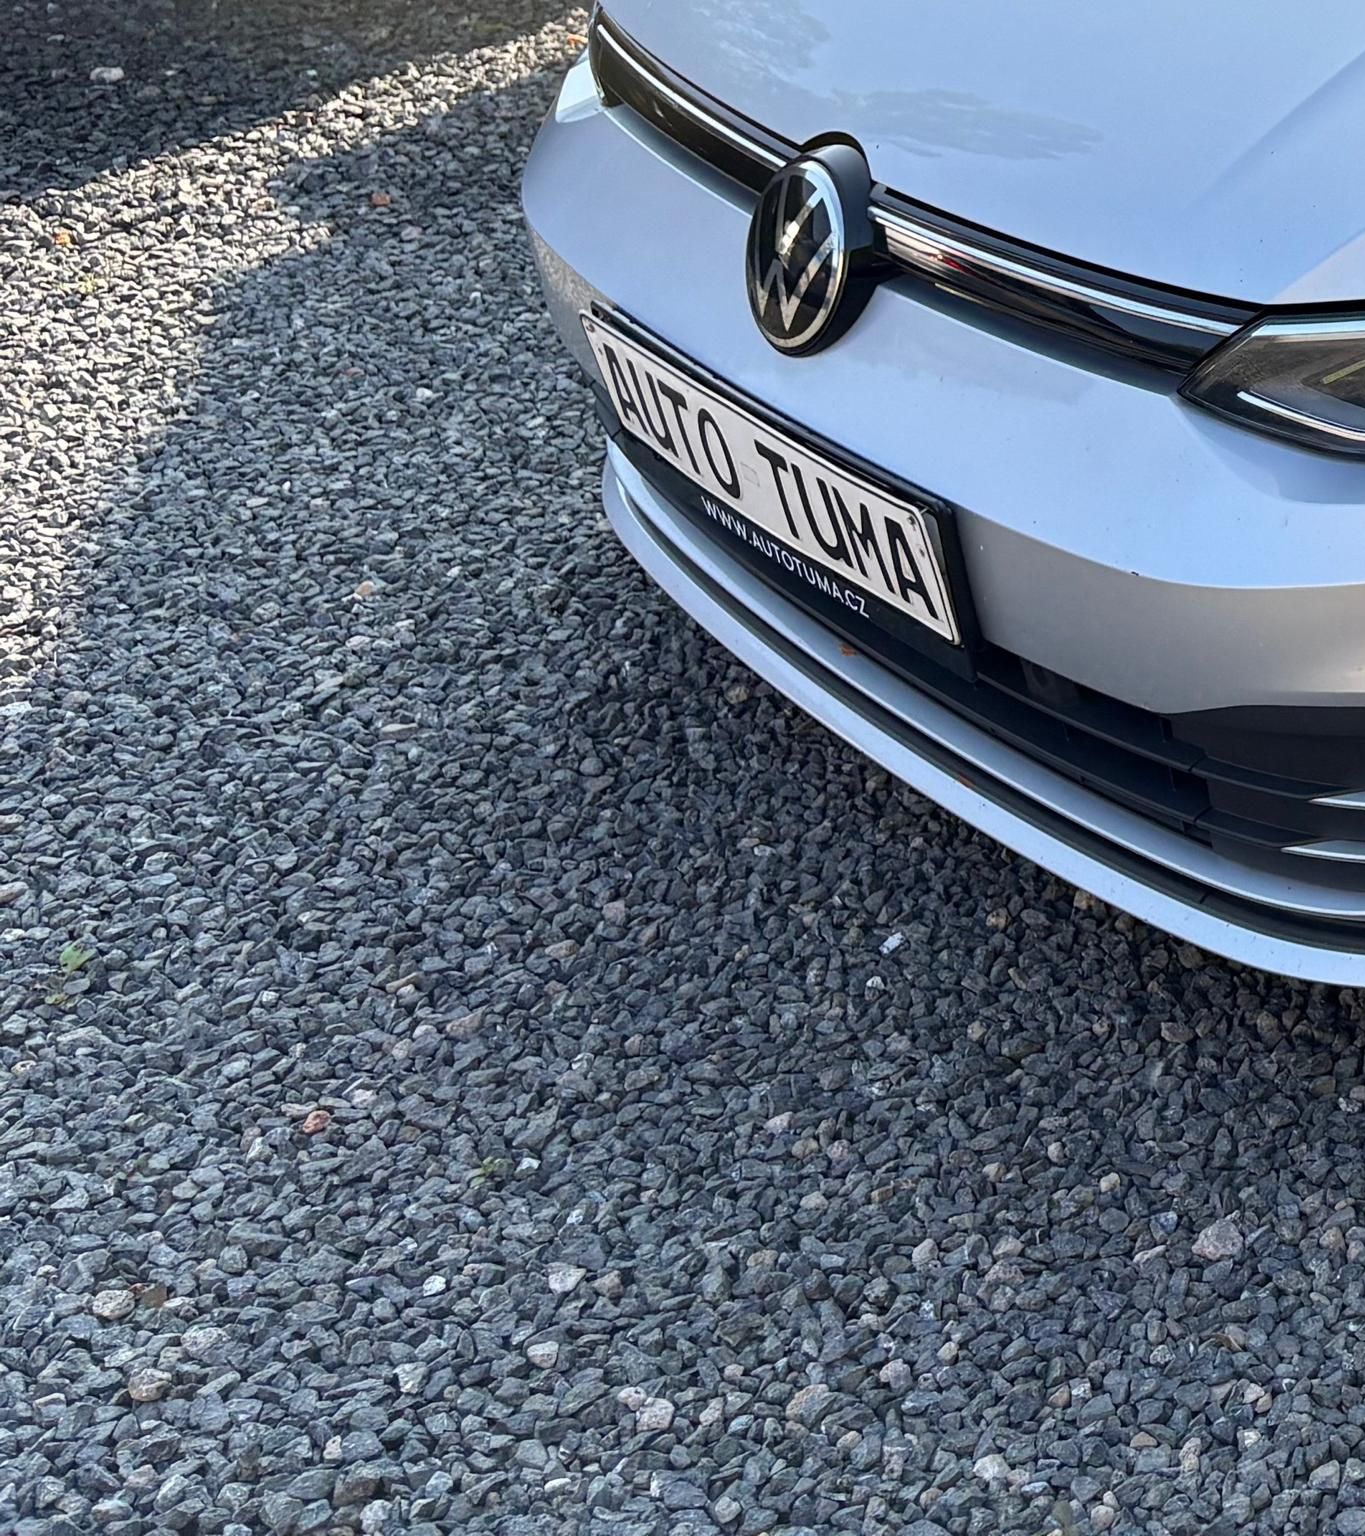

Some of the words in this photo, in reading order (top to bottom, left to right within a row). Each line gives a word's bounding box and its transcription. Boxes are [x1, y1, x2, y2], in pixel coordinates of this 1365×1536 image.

[602, 342, 741, 500] AUTO
[753, 438, 940, 621] TUMA
[700, 495, 870, 619] WWW.AUTOTUMA.CZ
